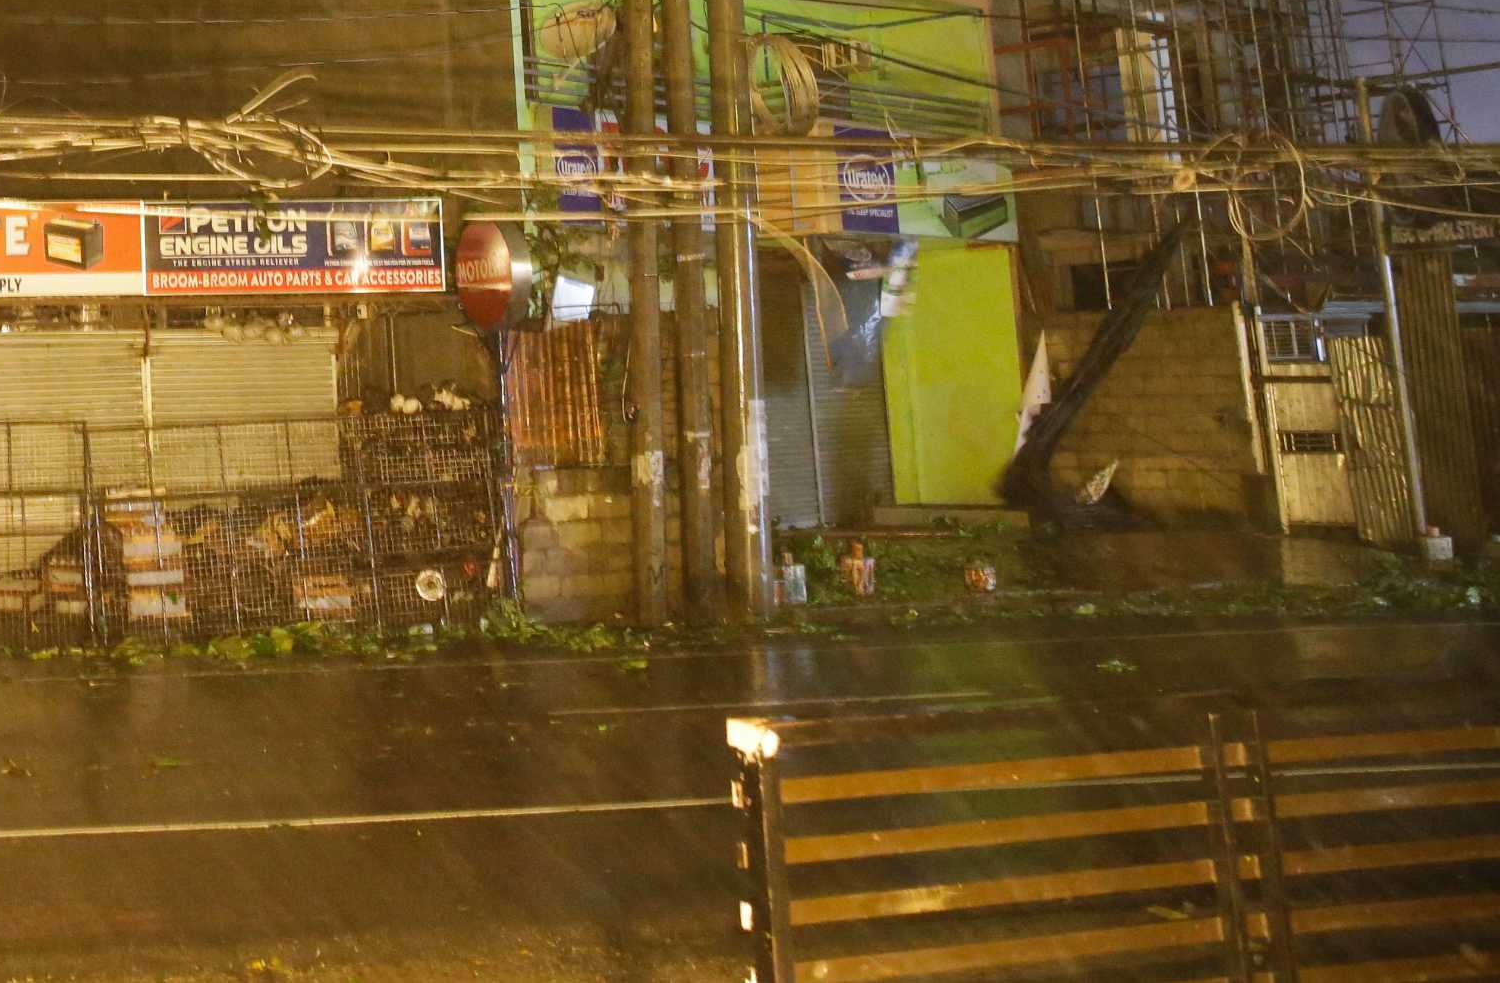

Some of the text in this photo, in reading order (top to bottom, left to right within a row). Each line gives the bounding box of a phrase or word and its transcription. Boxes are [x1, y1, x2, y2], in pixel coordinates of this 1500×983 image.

[159, 234, 308, 256] ENGINE OILS
[173, 258, 300, 267] THE ENGINE STRESS RELIEVER
[153, 272, 248, 289] BROOM-BROOM
[251, 271, 283, 287] AUTO
[286, 270, 321, 286] PARTS
[324, 270, 333, 285] &
[363, 269, 440, 285] ACCESSORIES
